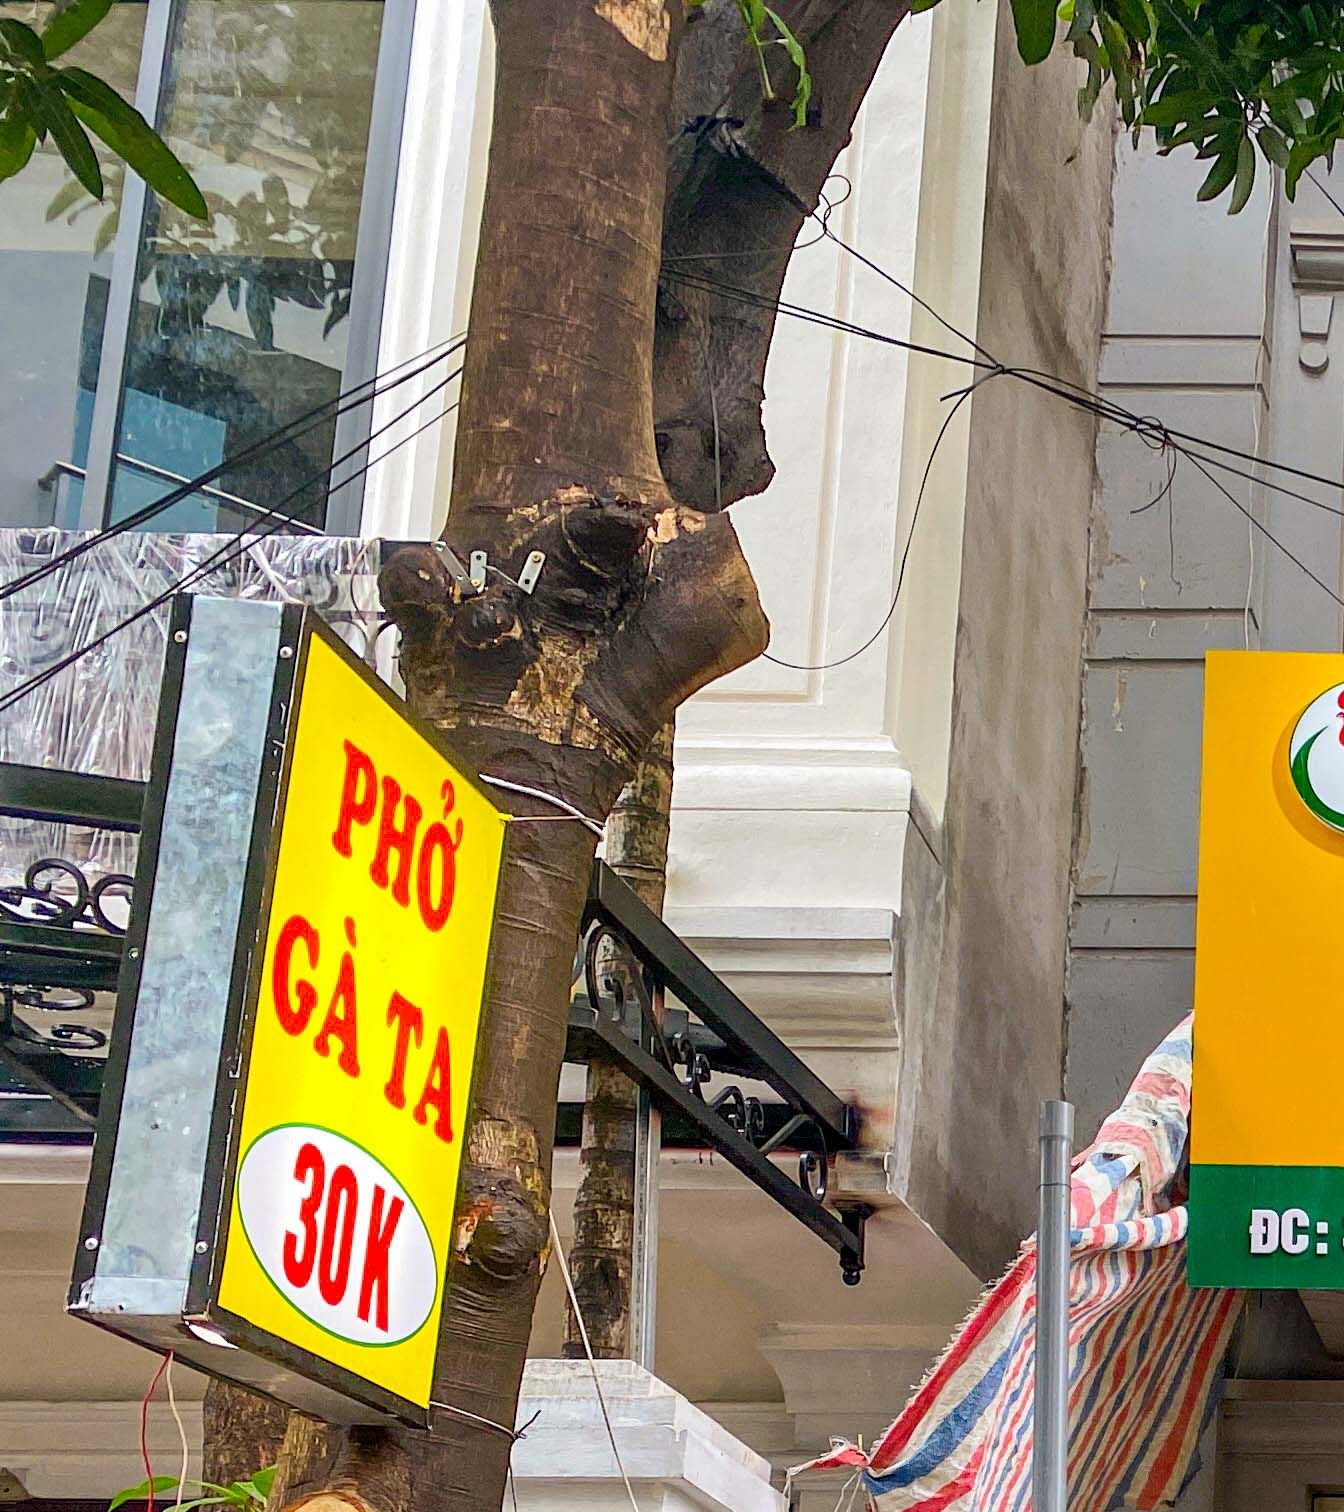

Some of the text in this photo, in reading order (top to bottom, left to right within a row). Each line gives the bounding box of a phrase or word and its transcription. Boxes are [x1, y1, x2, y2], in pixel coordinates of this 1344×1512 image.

[332, 738, 465, 932] PHỞ
[273, 914, 456, 1144] GÀ TA
[1248, 1210, 1329, 1257] ĐC:
